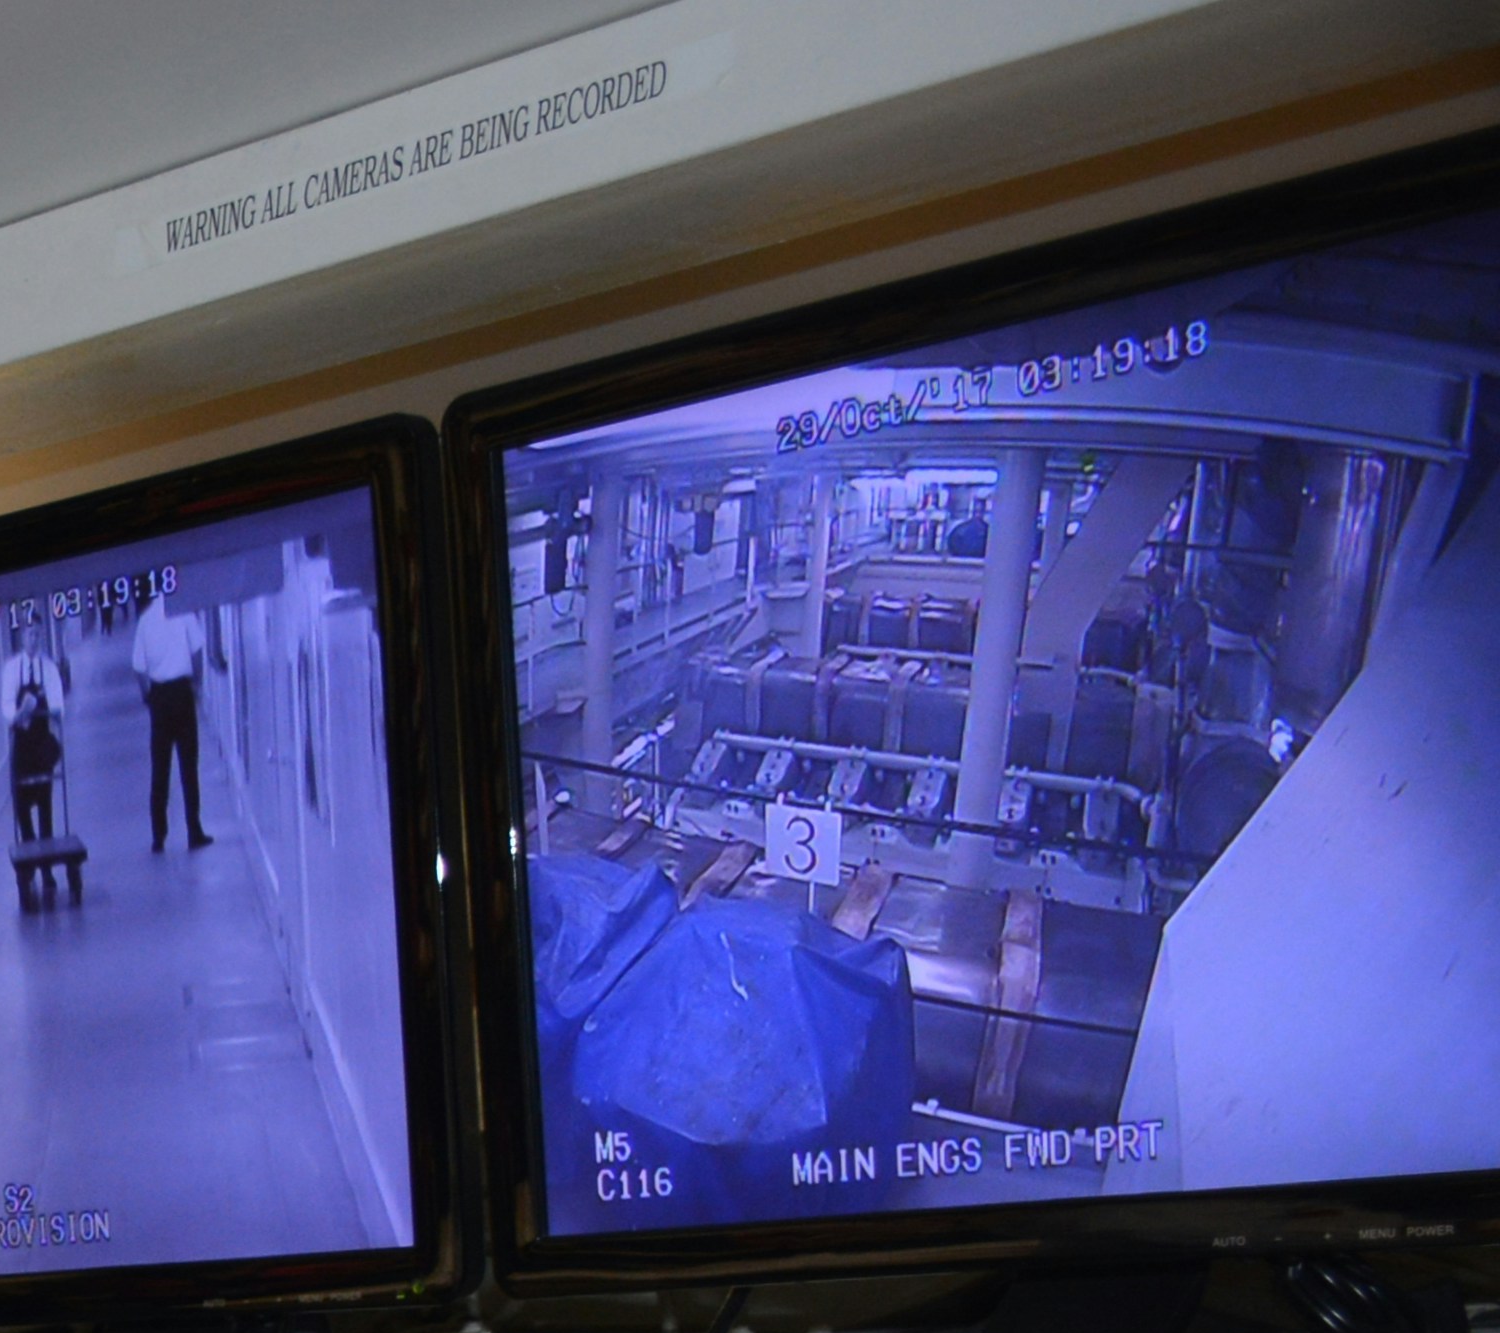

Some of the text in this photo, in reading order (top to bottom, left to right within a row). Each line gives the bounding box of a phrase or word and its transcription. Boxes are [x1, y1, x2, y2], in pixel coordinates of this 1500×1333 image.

[165, 60, 668, 254] WARNING ALL CAMERAS ARE BEING RECORDED
[1017, 322, 1209, 396] 03:19:18
[53, 566, 177, 619] 03:19:18
[785, 815, 817, 875] 3
[594, 1131, 632, 1163] M5
[793, 1121, 1163, 1186] MAIN ENGS FWD PRT
[4, 1184, 34, 1214] S2
[598, 1167, 673, 1201] C116
[1213, 1225, 1454, 1247] AUTO MENU POWER
